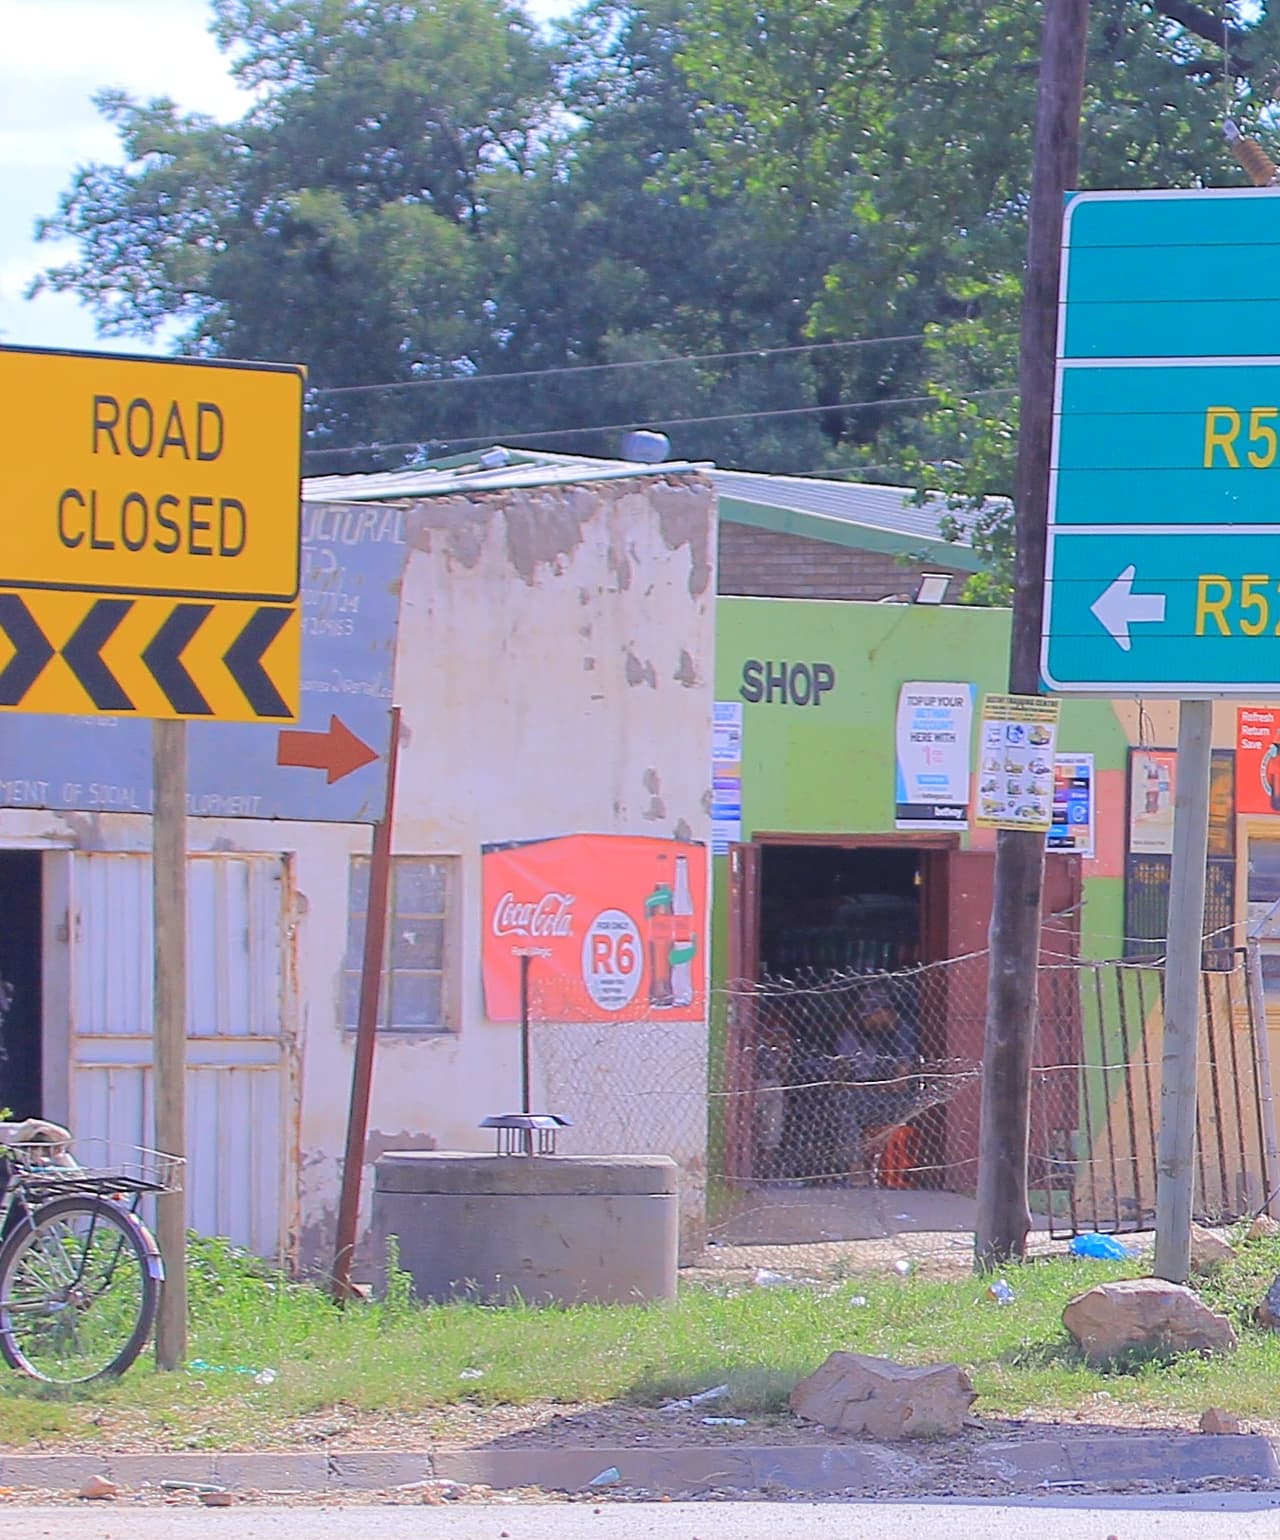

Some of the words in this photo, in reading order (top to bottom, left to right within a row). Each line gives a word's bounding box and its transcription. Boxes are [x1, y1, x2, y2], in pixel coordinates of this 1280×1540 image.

[91, 394, 225, 462] ROAD
[56, 488, 248, 558] CLOSED
[740, 659, 836, 706] SHOP
[937, 697, 963, 708] YOUR
[1242, 711, 1275, 722] Refresh
[1241, 725, 1271, 736] Return
[910, 731, 932, 743] HERE
[934, 732, 956, 743] WITH
[1241, 738, 1263, 749] Save
[591, 933, 635, 975] R6
